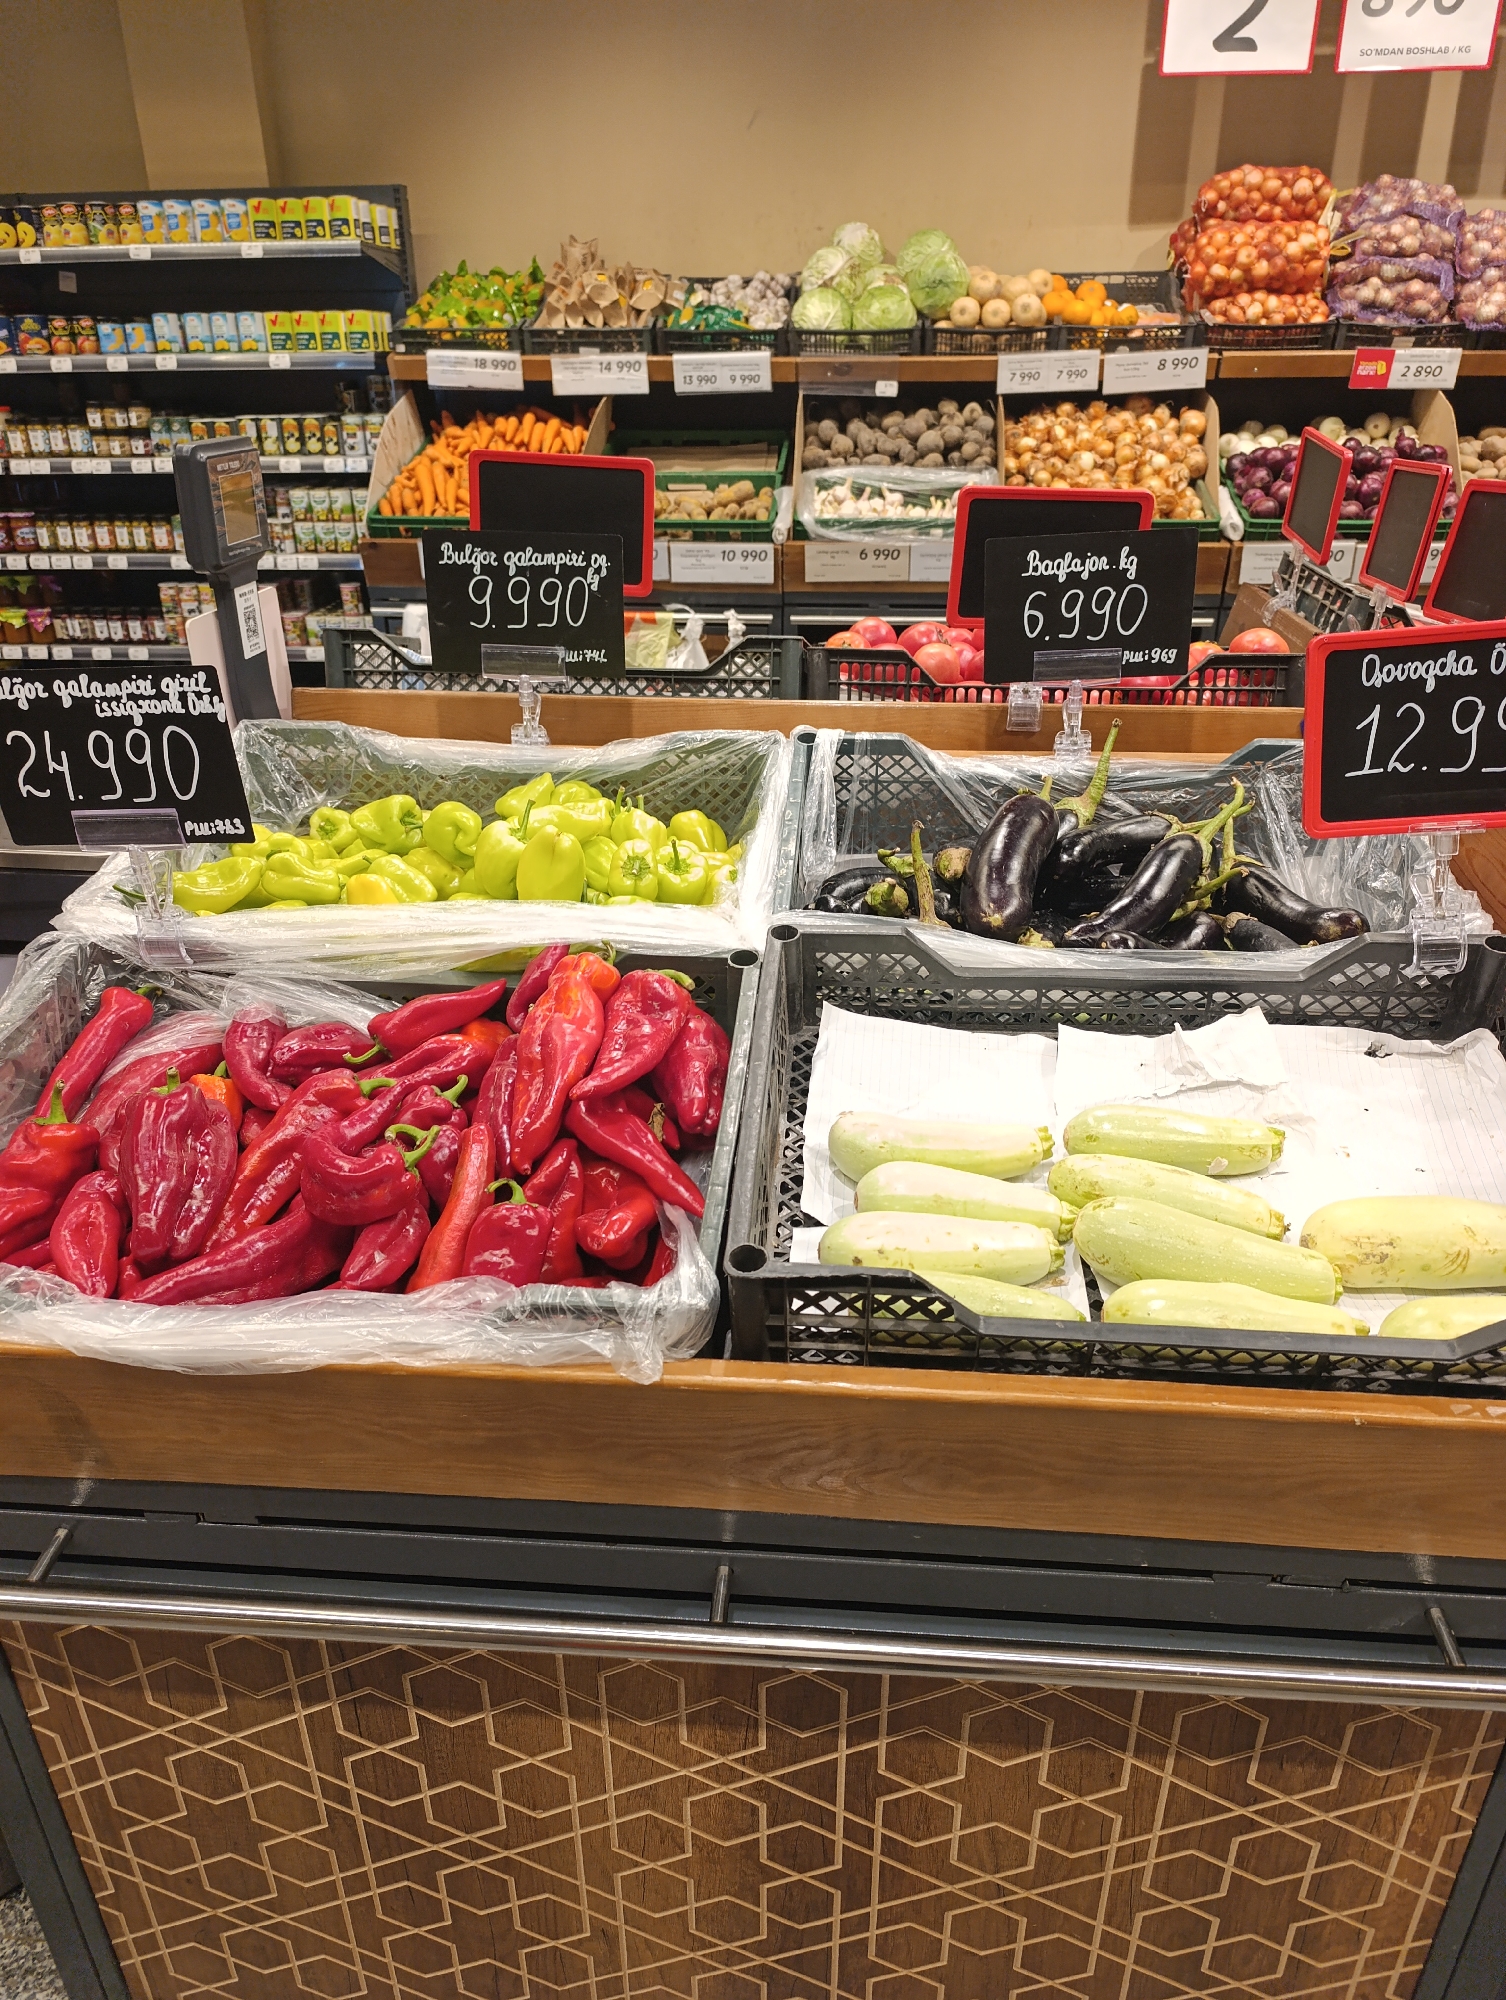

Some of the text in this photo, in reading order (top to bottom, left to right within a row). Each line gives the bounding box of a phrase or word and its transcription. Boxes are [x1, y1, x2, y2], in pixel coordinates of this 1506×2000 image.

[1406, 46, 1450, 55] BOSHLAB
[1458, 45, 1472, 54] KG
[474, 358, 487, 369] 18
[491, 359, 517, 371] 990
[599, 361, 612, 373] 14
[616, 360, 642, 373] 990
[1157, 358, 1167, 371] 8
[1171, 356, 1199, 370] 990
[1009, 371, 1041, 382] 7 990
[1056, 368, 1088, 380] 7 990
[1401, 365, 1443, 377] 2 890
[683, 374, 717, 385] 13 990
[729, 374, 761, 384] 9 990
[720, 549, 736, 562] 10
[740, 549, 768, 562] 990
[859, 548, 868, 561] 6
[873, 548, 900, 561] 990
[468, 575, 589, 629] 9.990
[1023, 583, 1148, 641] 6.990
[1345, 695, 1506, 778] 12.9
[6, 725, 200, 803] 24.990
